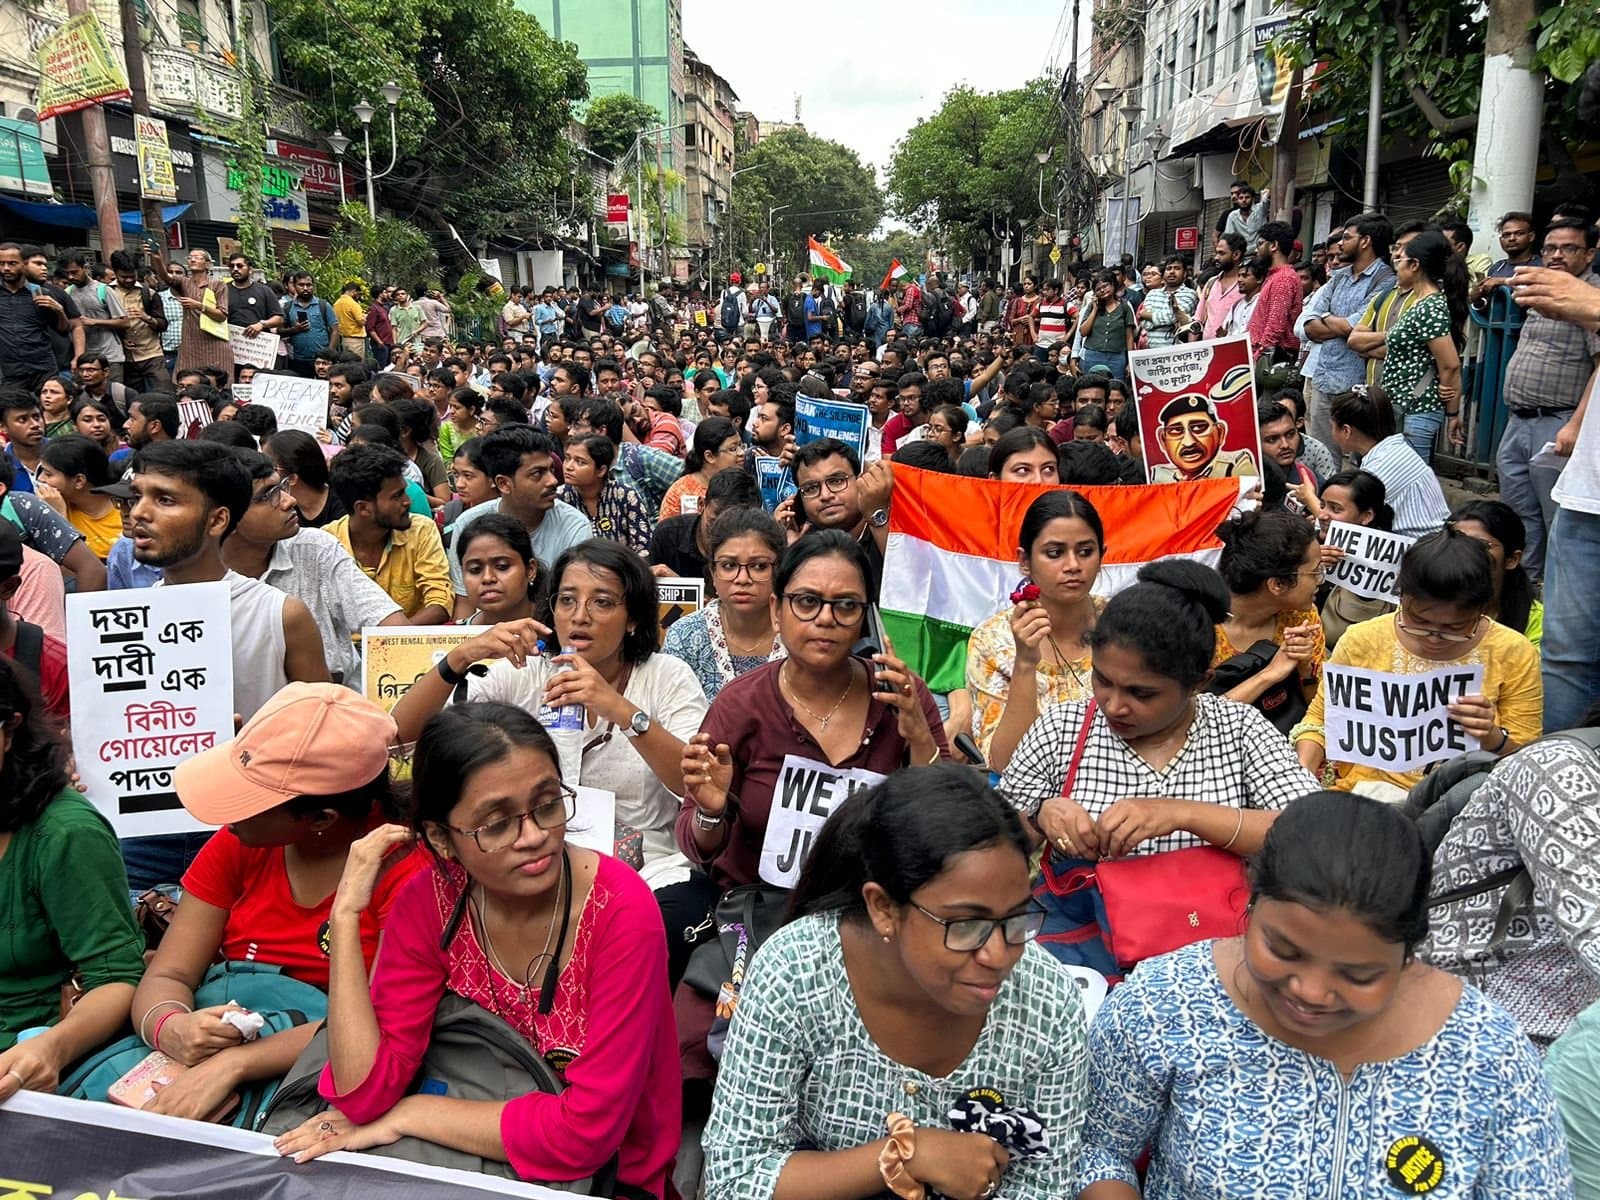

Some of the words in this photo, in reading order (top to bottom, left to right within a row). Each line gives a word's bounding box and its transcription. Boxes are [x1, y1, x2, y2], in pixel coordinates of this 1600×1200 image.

[262, 379, 326, 401] BREAK
[277, 412, 325, 428] LENCE
[830, 410, 862, 424] SILENCE
[808, 425, 821, 436] THE
[822, 428, 860, 442] VIOLENCE
[1329, 527, 1362, 555] WE
[1365, 535, 1412, 565] WAN
[89, 605, 151, 632] দফা
[158, 620, 205, 644] এক
[383, 637, 399, 647] WEST
[400, 636, 424, 646] BENGAL
[426, 636, 447, 646] JUNIOR
[92, 643, 156, 679] দাবী
[160, 667, 207, 692] এক
[1327, 671, 1373, 712] WE
[1381, 673, 1475, 718] WANT
[124, 700, 197, 733] বিনীত
[98, 731, 217, 763] গোয়েলের
[1338, 717, 1466, 762] JUSTICE
[109, 764, 176, 792] পদত
[781, 766, 838, 818] WE
[980, 1088, 1003, 1104] DEMAND
[1387, 1154, 1397, 1168] WE
[1399, 1145, 1436, 1185] JUSTICE
